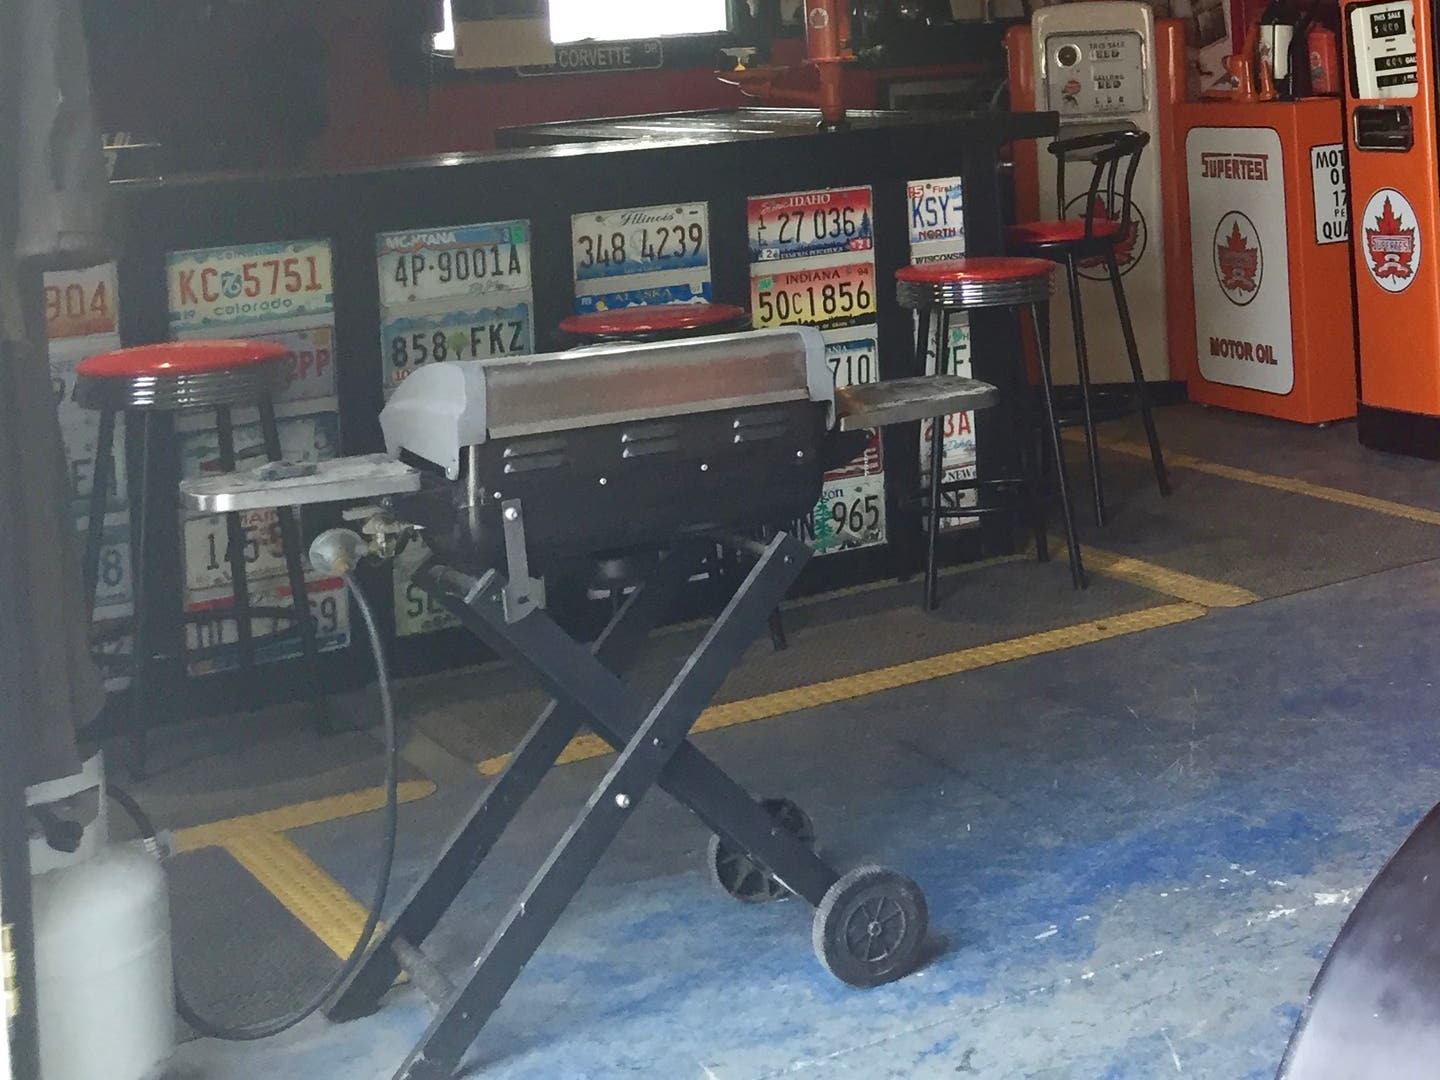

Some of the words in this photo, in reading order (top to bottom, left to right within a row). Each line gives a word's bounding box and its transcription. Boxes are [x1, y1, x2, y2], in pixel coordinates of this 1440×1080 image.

[1387, 12, 1401, 20] SALE
[560, 47, 631, 68] CORVETTE
[1201, 152, 1269, 181] SUPERTEST
[789, 193, 831, 207] IDAHO
[620, 213, 675, 226] Illinois
[777, 210, 804, 244] 27
[813, 206, 855, 240] 036
[578, 232, 626, 267] 348
[640, 223, 703, 261] 4239
[918, 227, 956, 240] NORTH
[178, 267, 219, 305] KC
[242, 256, 322, 298] 5751
[786, 270, 840, 285] INDIANA
[214, 297, 293, 317] colorado
[392, 331, 447, 367] 858
[471, 320, 525, 357] FKZ
[1209, 336, 1253, 362] MOTOR
[1256, 345, 1278, 366] OIL
[832, 495, 879, 536] 965
